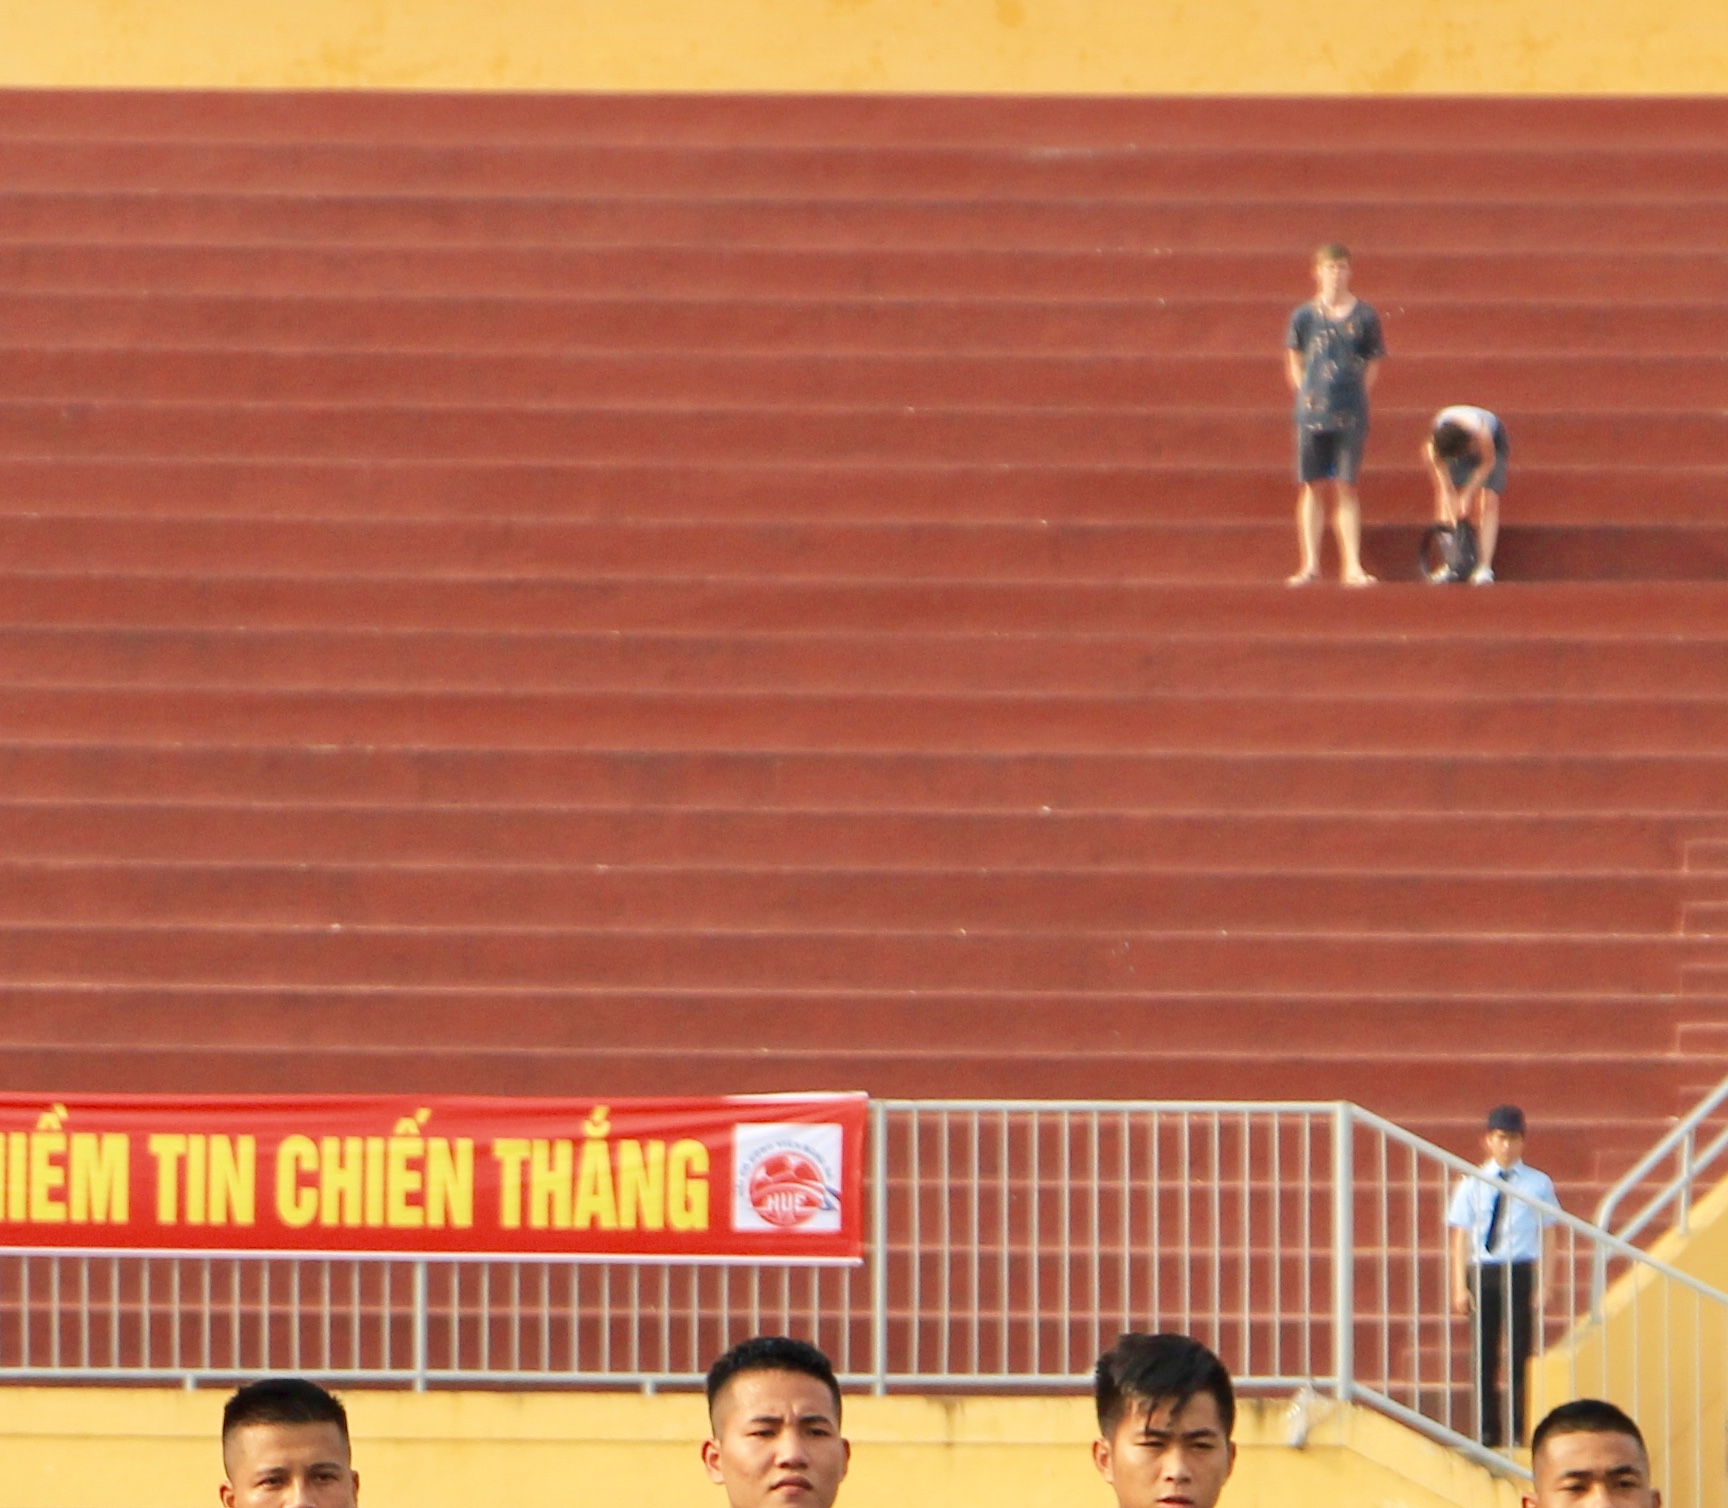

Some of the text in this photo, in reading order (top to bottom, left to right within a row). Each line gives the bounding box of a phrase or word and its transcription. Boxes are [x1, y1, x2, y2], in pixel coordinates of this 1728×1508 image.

[149, 1133, 255, 1225] TIN
[275, 1107, 474, 1228] CHIẾN
[493, 1105, 710, 1231] THẮNG
